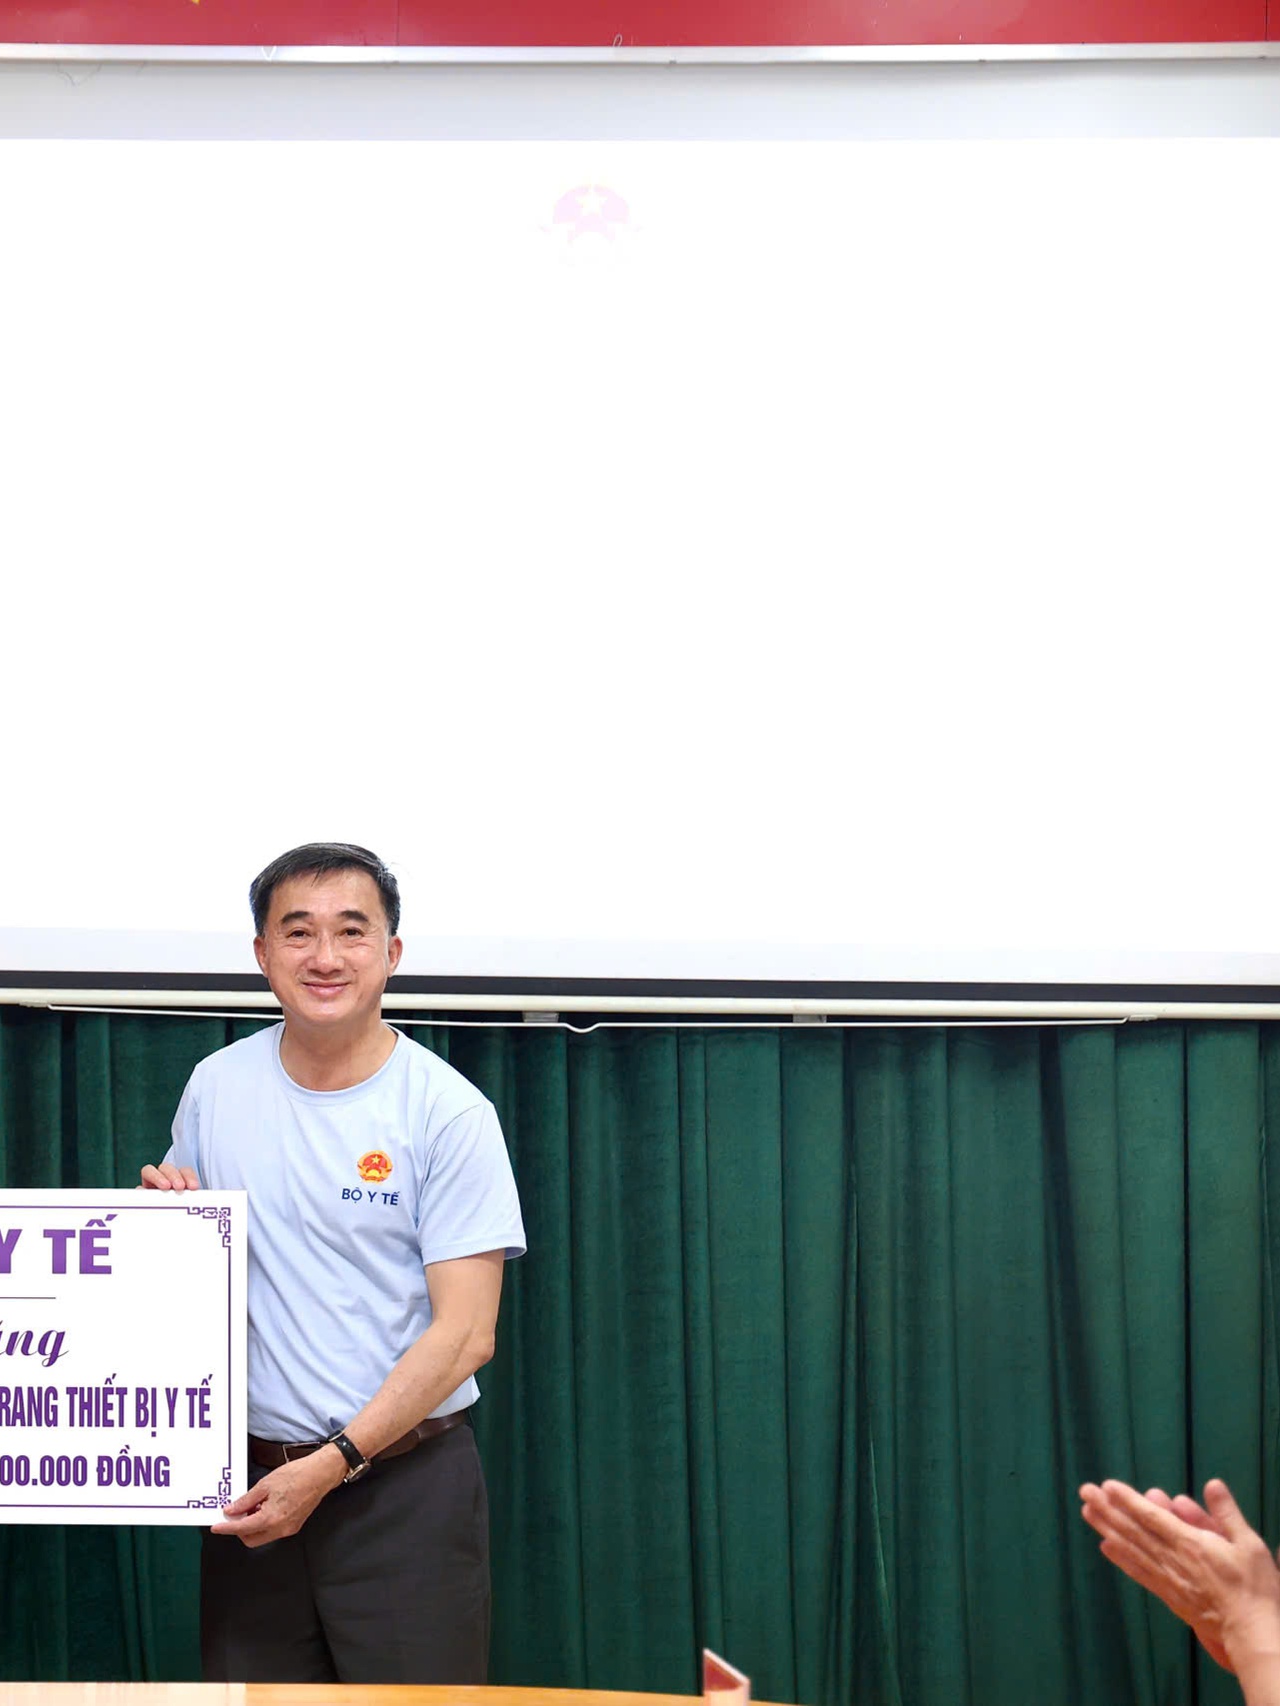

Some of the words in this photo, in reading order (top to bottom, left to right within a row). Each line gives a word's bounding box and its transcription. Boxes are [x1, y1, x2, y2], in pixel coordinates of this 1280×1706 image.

[342, 1187, 363, 1204] BỘ
[367, 1191, 378, 1203] Y
[381, 1191, 400, 1206] TẾ
[43, 1214, 117, 1274] TẾ
[66, 1373, 128, 1427] THIẾT
[135, 1387, 157, 1437] BỊ
[165, 1387, 178, 1428] Y
[186, 1374, 213, 1428] TẾ
[96, 1445, 170, 1487] ĐỒNG
